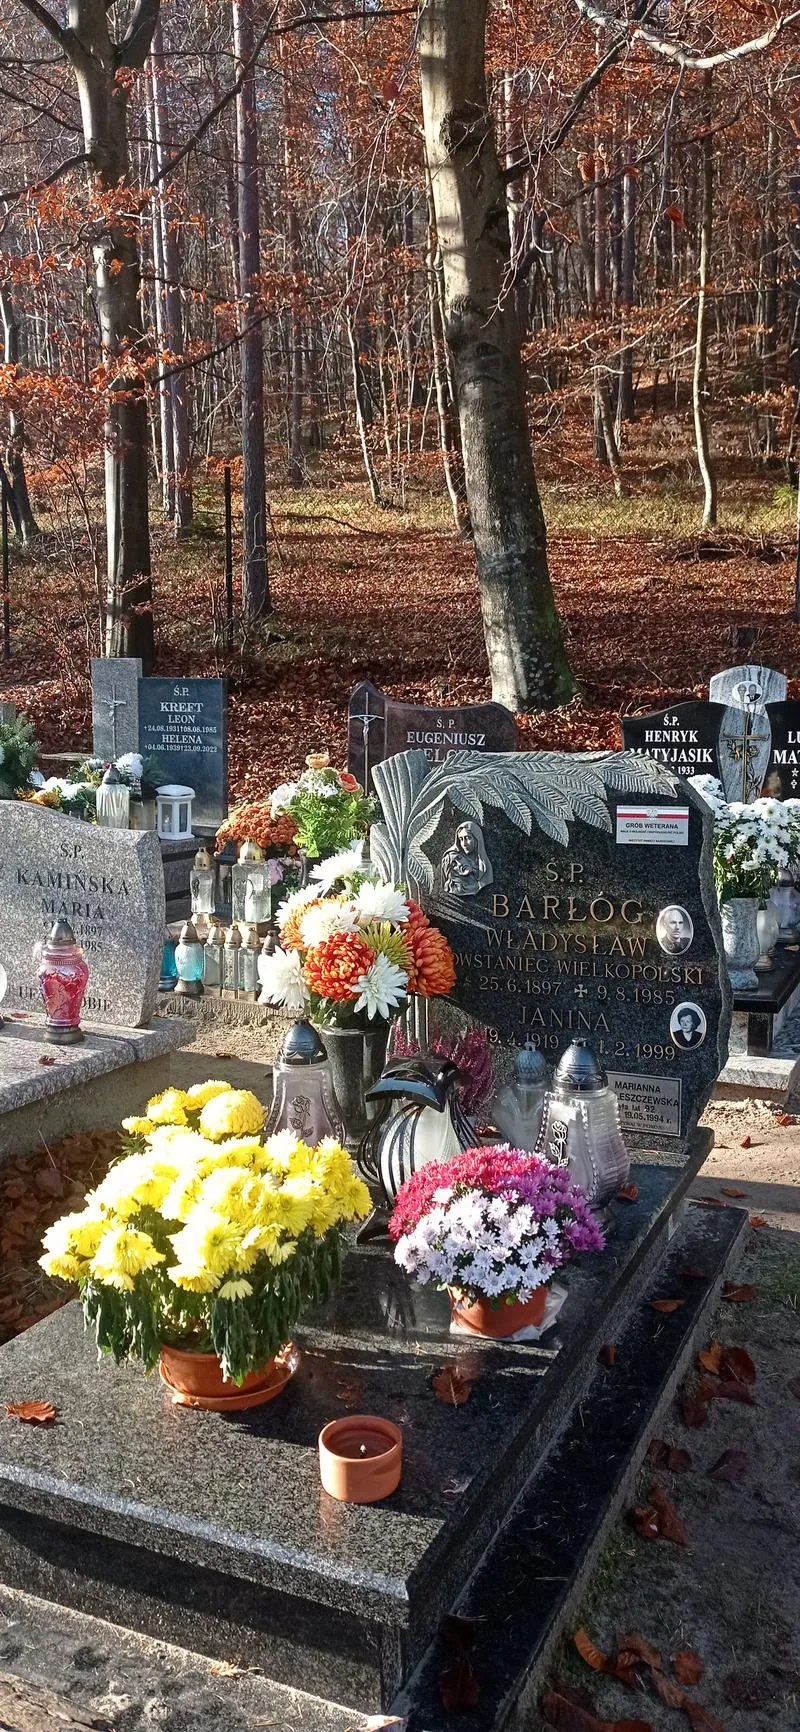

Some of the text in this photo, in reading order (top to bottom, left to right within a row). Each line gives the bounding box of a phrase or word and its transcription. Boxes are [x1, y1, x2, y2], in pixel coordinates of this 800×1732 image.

[160, 701, 203, 712] KREFT
[168, 715, 195, 723] LEON
[663, 713, 680, 726] Ś.P.
[162, 734, 202, 744] HELENA
[407, 731, 486, 746] EUGENIUSZ
[645, 730, 698, 742] HENRYK
[16, 868, 130, 896] KAMIŃSKA
[41, 899, 104, 919] MARIA
[492, 892, 644, 923] BARŁÓG
[485, 929, 650, 957] WŁADYSŁAW
[557, 959, 703, 985] WIELKOPOLSKI
[518, 1006, 609, 1032] JANINA
[614, 1080, 661, 1093] MARIANNA
[645, 1105, 656, 1113] 92
[624, 1111, 664, 1122] 19.05.1994
